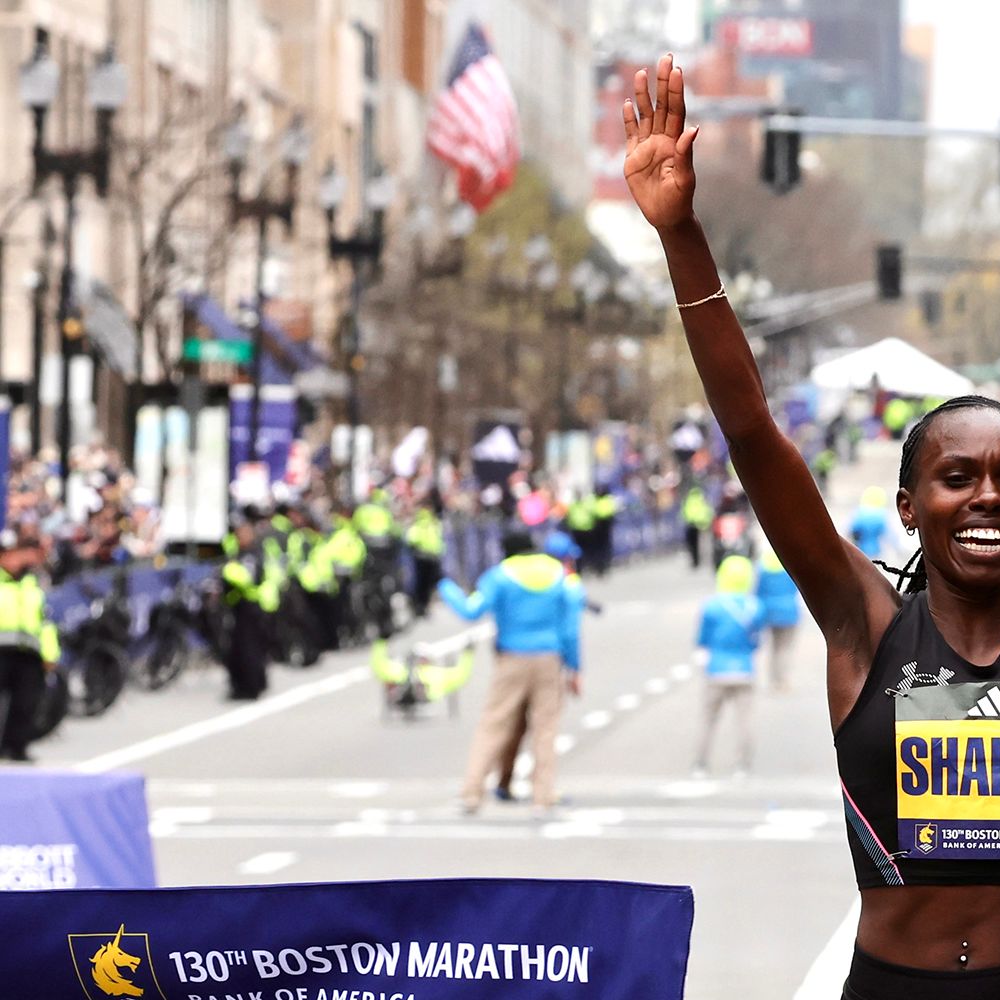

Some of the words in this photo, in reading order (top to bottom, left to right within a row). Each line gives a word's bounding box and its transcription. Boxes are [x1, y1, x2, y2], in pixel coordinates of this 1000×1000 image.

[941, 829, 964, 840] 130TH
[169, 950, 247, 983] 130TH
[253, 941, 399, 979] BOSTON
[407, 941, 590, 984] MARATHON
